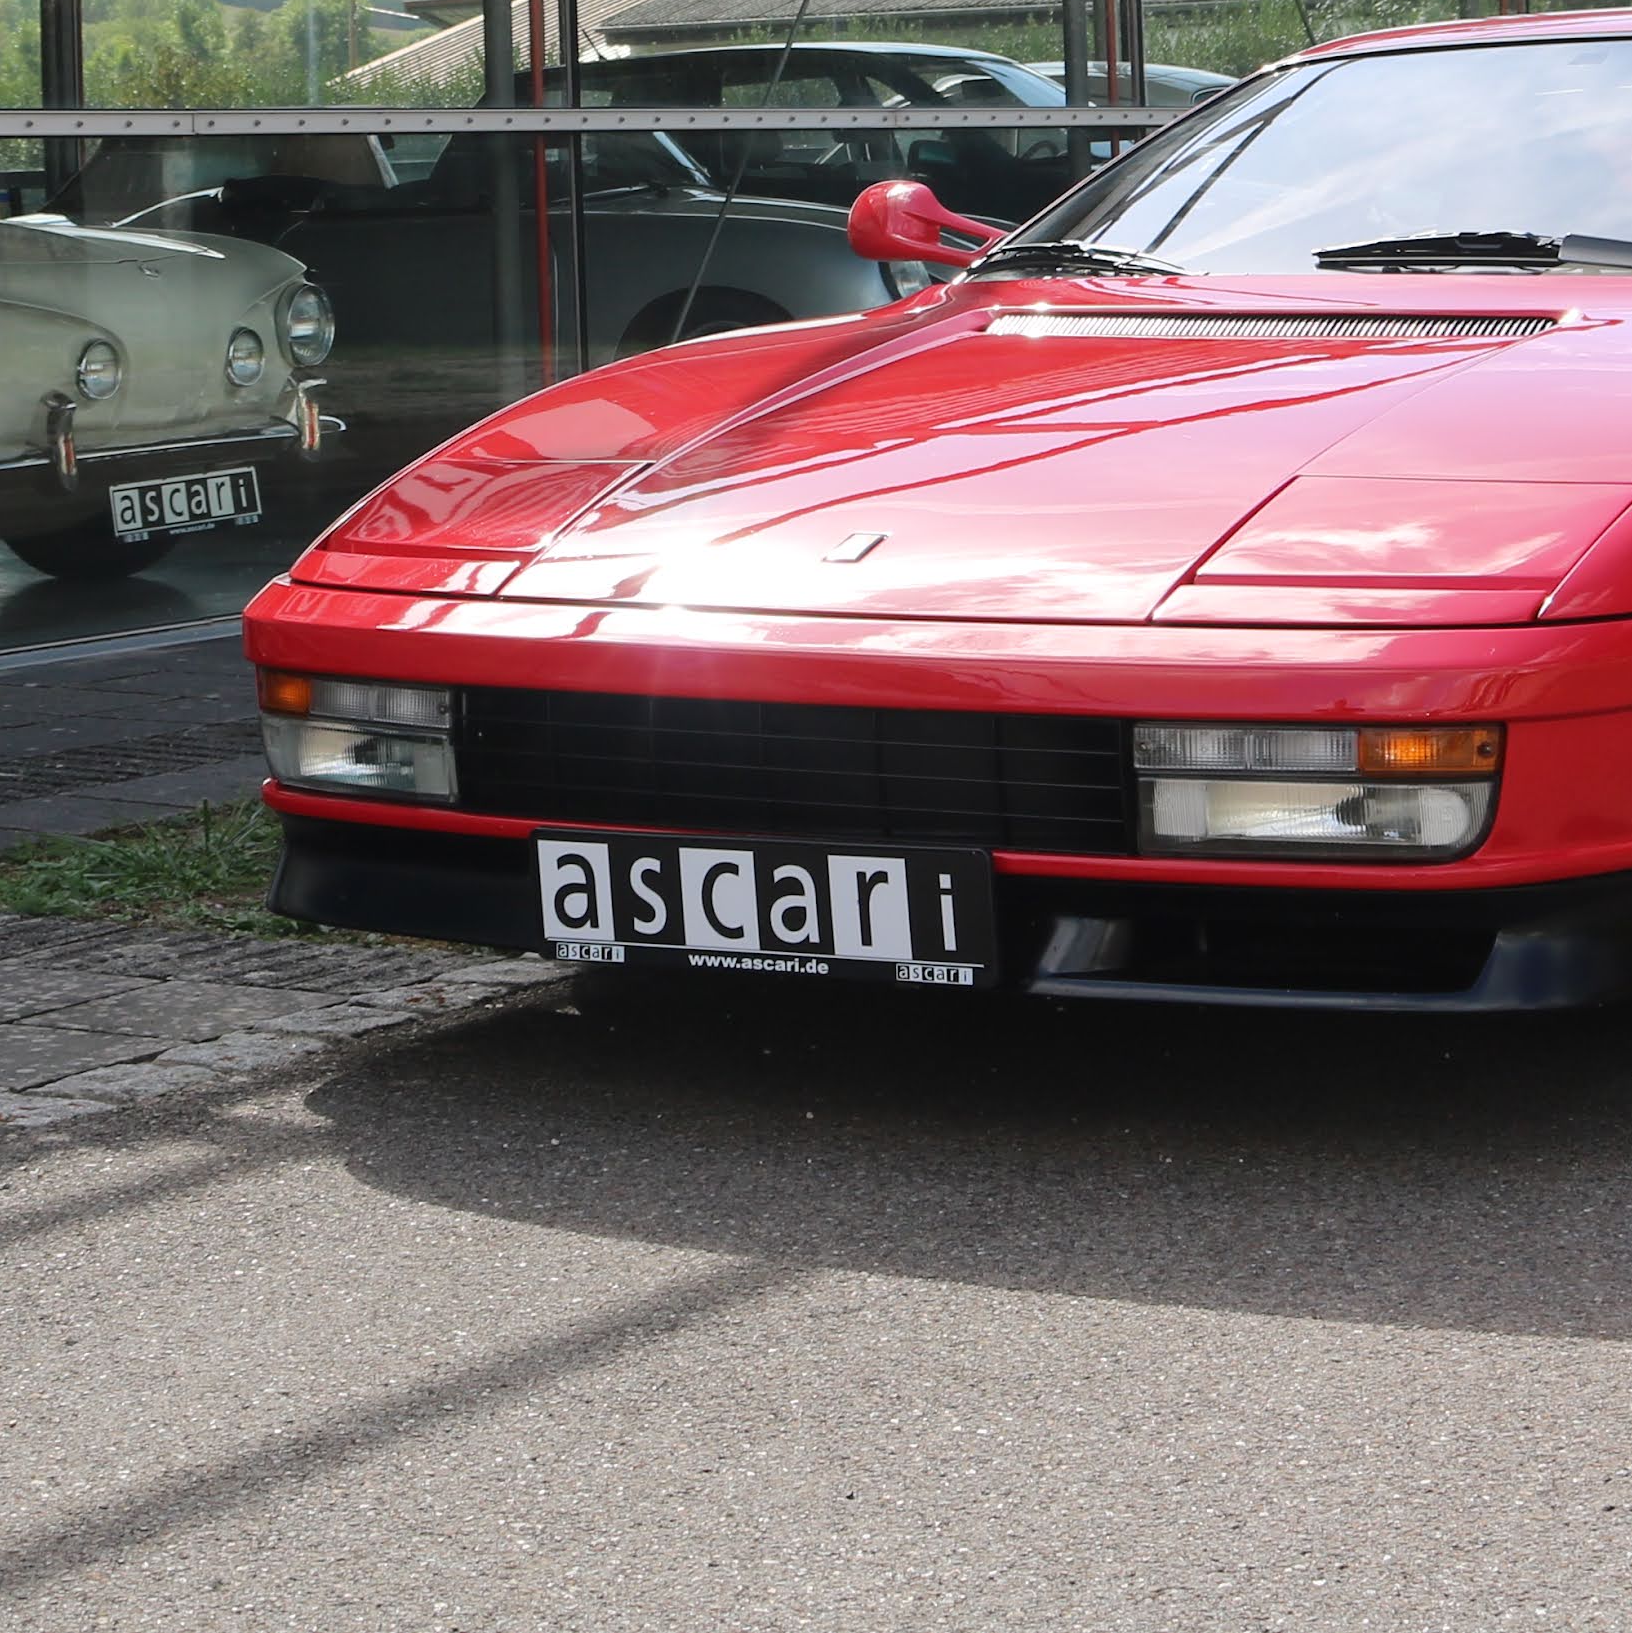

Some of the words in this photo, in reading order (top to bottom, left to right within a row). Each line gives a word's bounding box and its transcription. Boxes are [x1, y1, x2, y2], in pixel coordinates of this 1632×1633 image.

[120, 479, 247, 525] ascari
[553, 852, 957, 952] ascari
[557, 944, 622, 961] ascari
[688, 953, 830, 975] www.ascari.de
[898, 965, 970, 983] ascari
